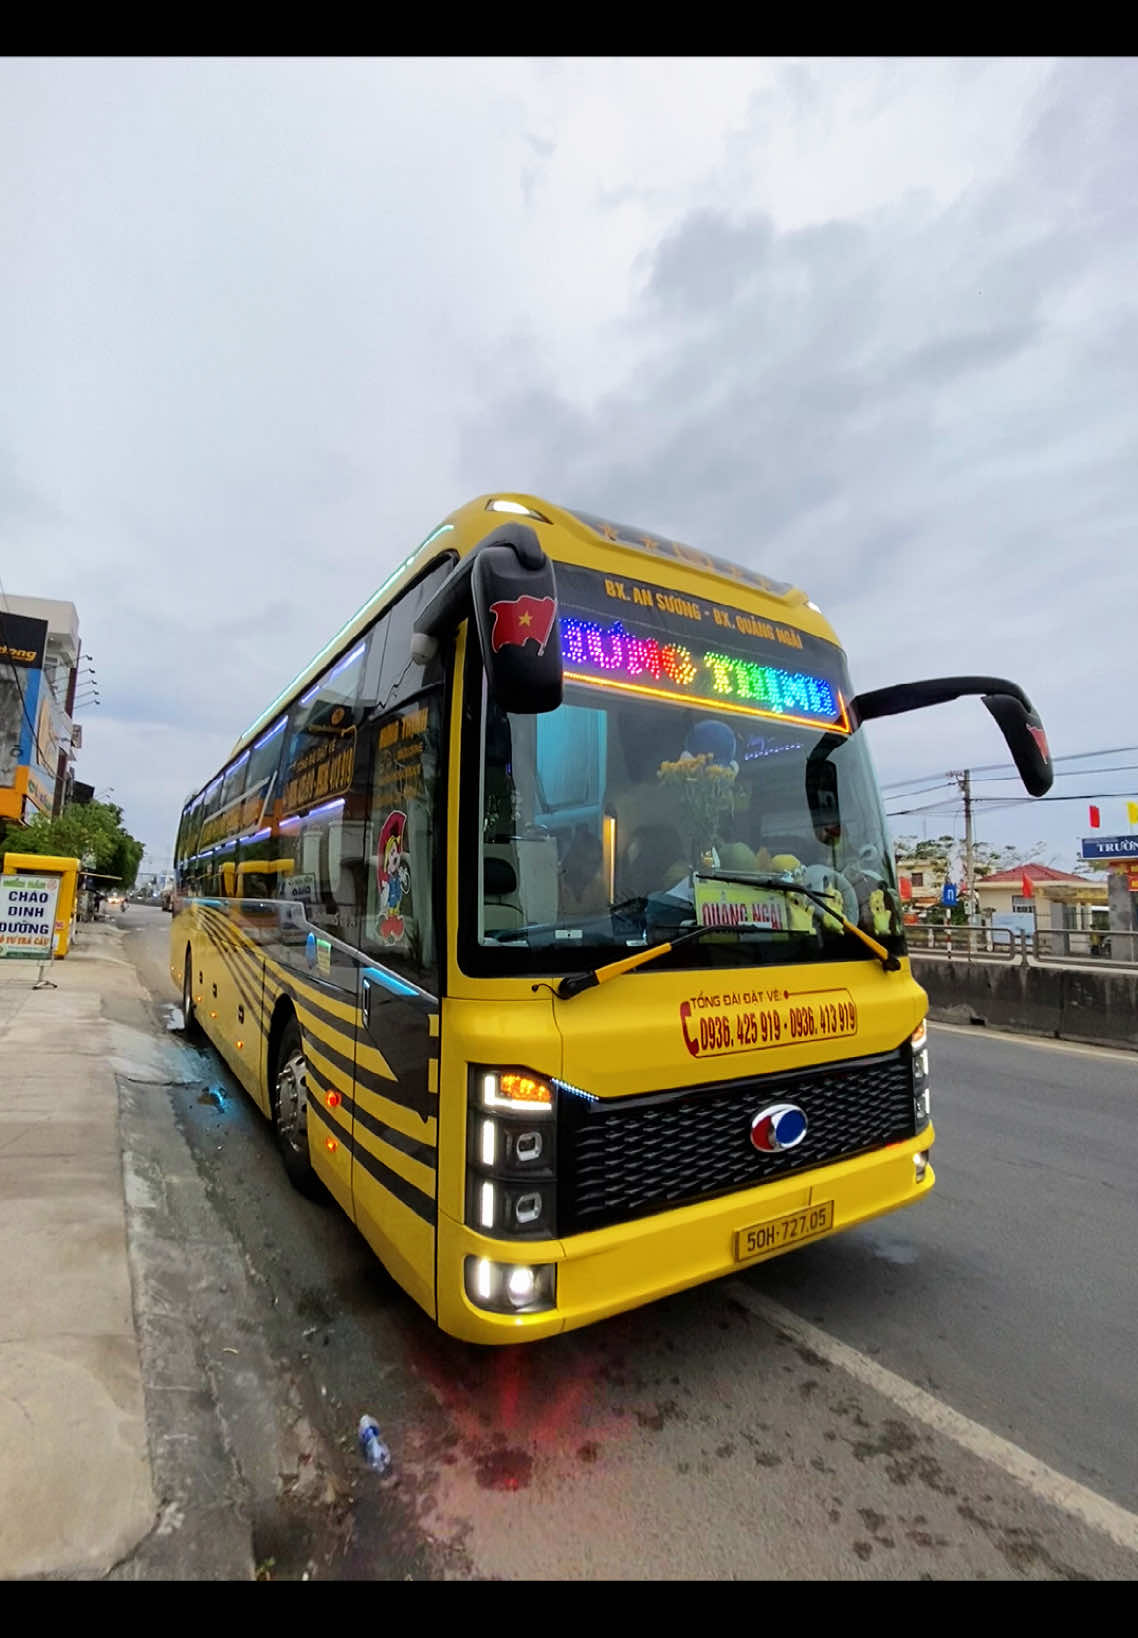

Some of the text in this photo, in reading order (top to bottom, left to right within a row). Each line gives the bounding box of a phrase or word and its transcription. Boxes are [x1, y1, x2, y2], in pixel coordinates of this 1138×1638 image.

[604, 579, 631, 601] BX.
[632, 587, 653, 607] AN
[690, 990, 721, 1009] TỔNG
[723, 992, 741, 1006] ĐÀI
[743, 990, 763, 1006] ĐẶT
[700, 1016, 734, 1051] 0936.
[737, 1011, 757, 1046] 425
[760, 1009, 780, 1042] 919
[789, 1005, 818, 1038] 0936.
[820, 1004, 837, 1035] 413
[838, 1001, 855, 1032] 919
